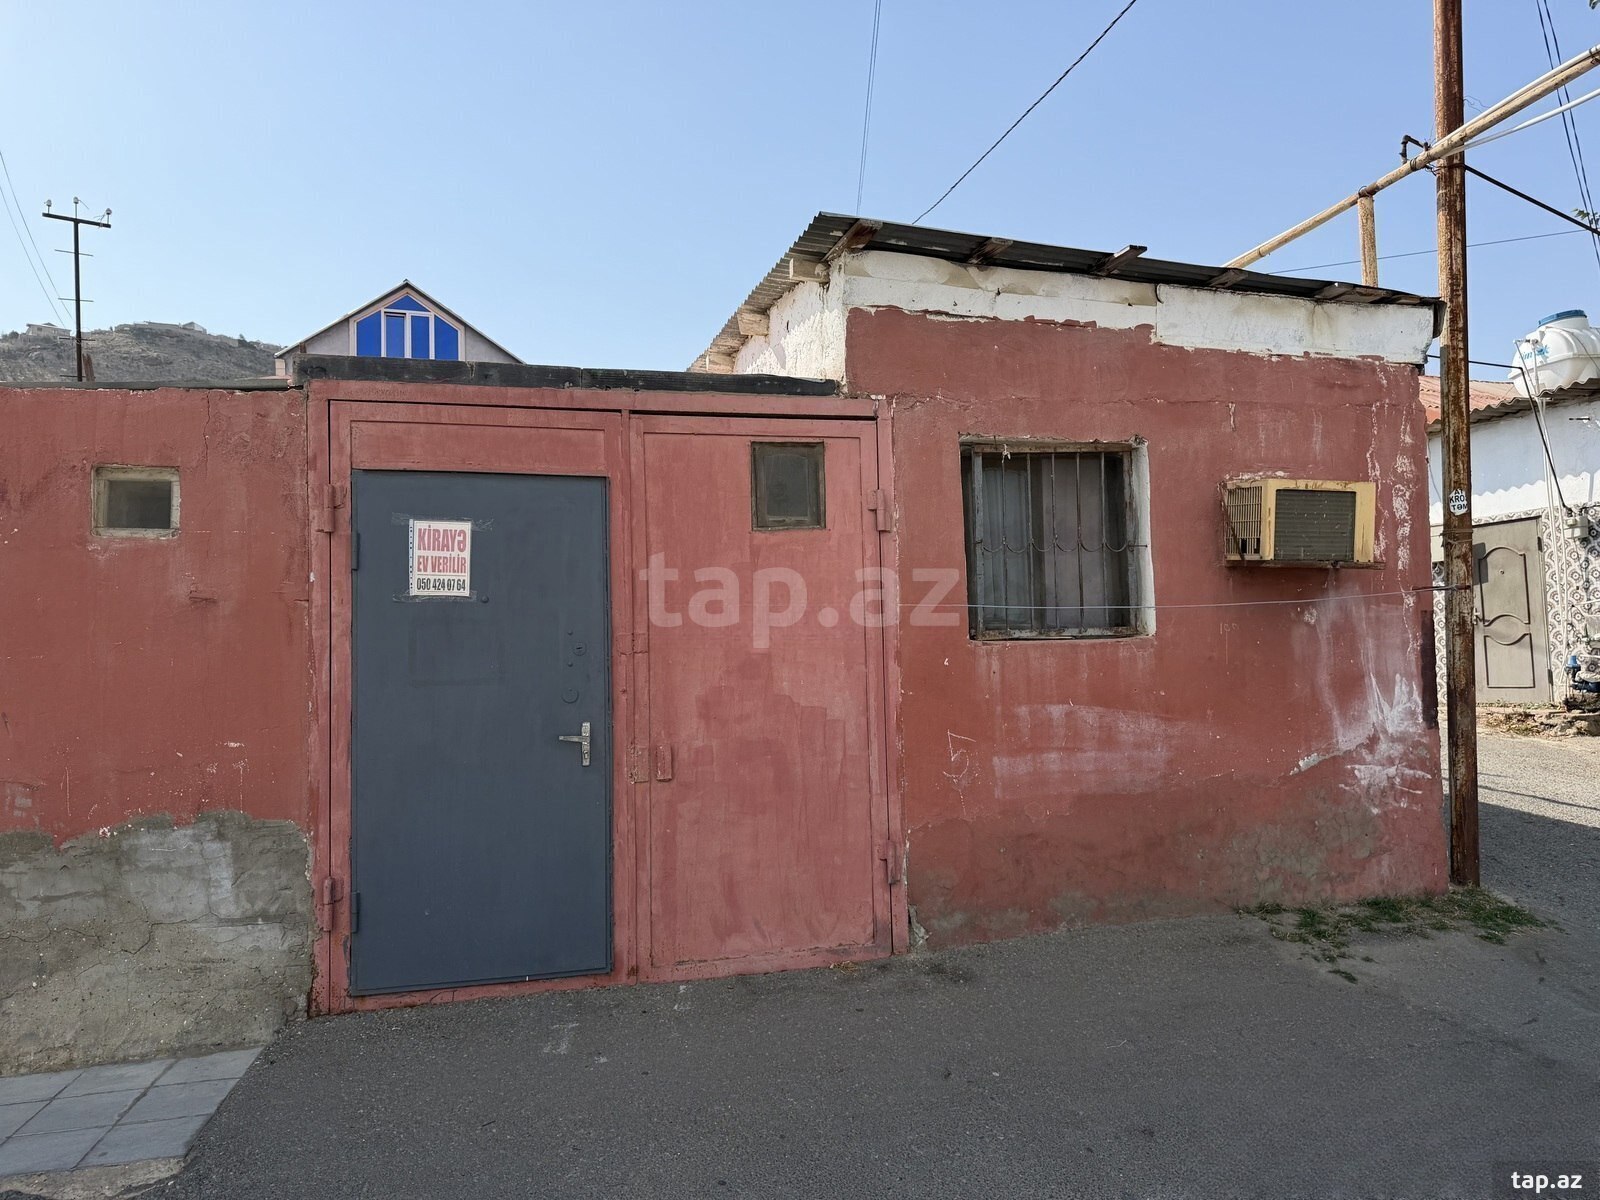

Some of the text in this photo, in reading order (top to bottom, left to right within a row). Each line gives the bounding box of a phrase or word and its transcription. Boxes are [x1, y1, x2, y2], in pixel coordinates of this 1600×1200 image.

[417, 524, 467, 553] KİRAYƏ
[417, 553, 467, 574] EV VERİLİR
[416, 577, 466, 592] 050 424 07 64
